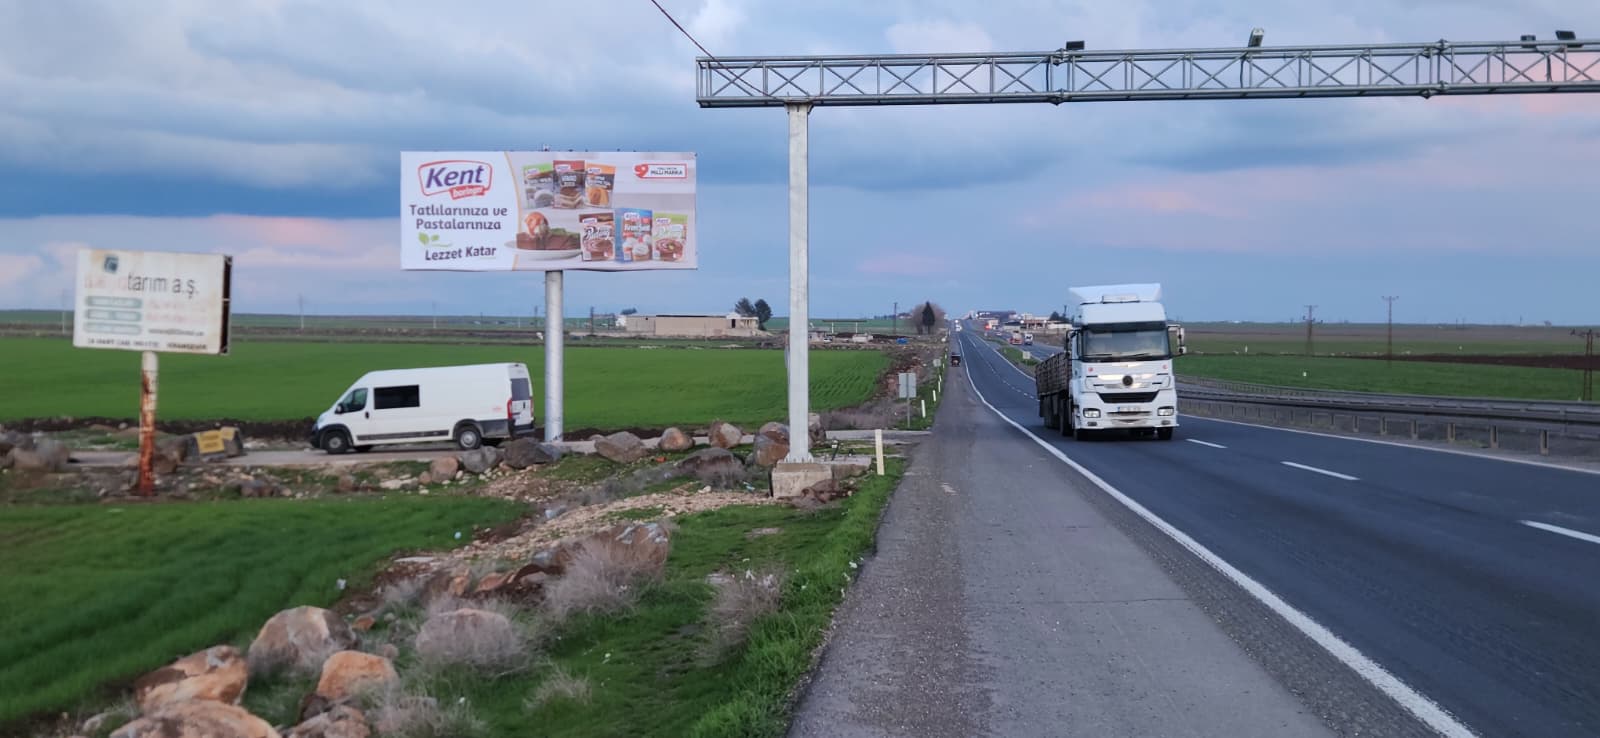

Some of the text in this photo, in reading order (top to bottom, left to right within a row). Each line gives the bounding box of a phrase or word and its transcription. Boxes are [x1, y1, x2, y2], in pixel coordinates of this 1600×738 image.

[425, 165, 485, 189] Kent
[409, 204, 508, 216] Tatlılarınıza ve
[416, 218, 502, 230] Pastalarınıza
[425, 245, 497, 261] Lezzet Katar
